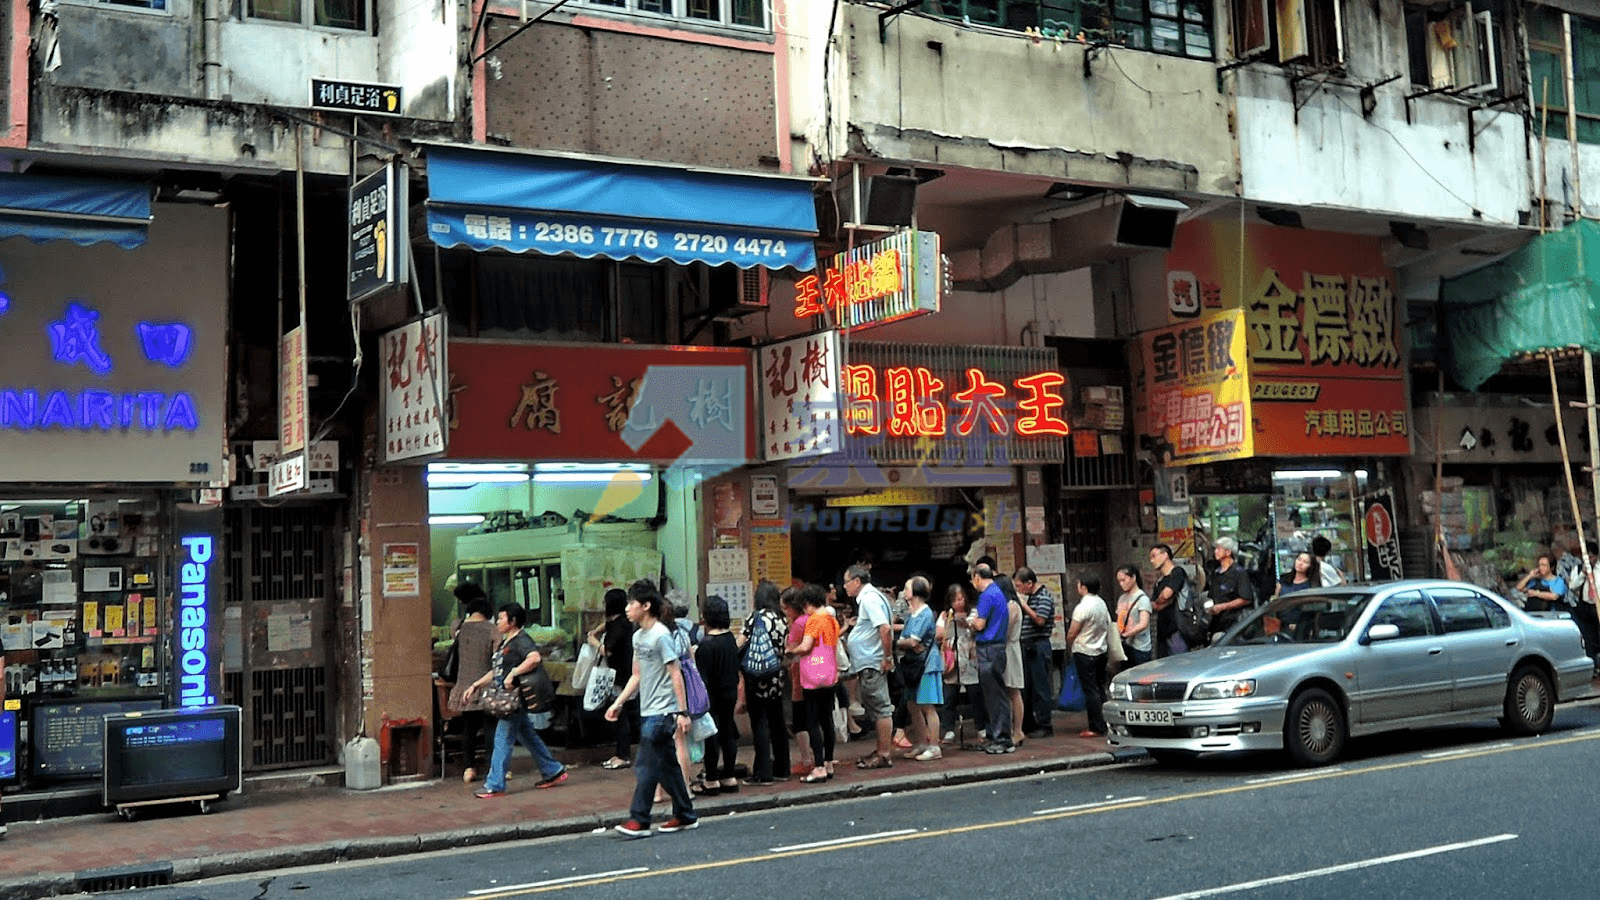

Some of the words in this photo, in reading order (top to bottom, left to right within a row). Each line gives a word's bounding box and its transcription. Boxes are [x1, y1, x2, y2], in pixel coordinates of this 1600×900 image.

[319, 84, 380, 108] 利貞足浴
[535, 222, 594, 244] 2386
[601, 226, 658, 249] 7776
[674, 233, 728, 253] 2720
[733, 238, 787, 257] 4474
[1248, 267, 1399, 365] 金標緻
[1253, 384, 1318, 398] PEUGEOT
[1, 390, 199, 429] NARITA
[1304, 409, 1409, 437] 汽車用品公司
[180, 535, 216, 708] Panasoni
[1144, 710, 1170, 724] 3302
